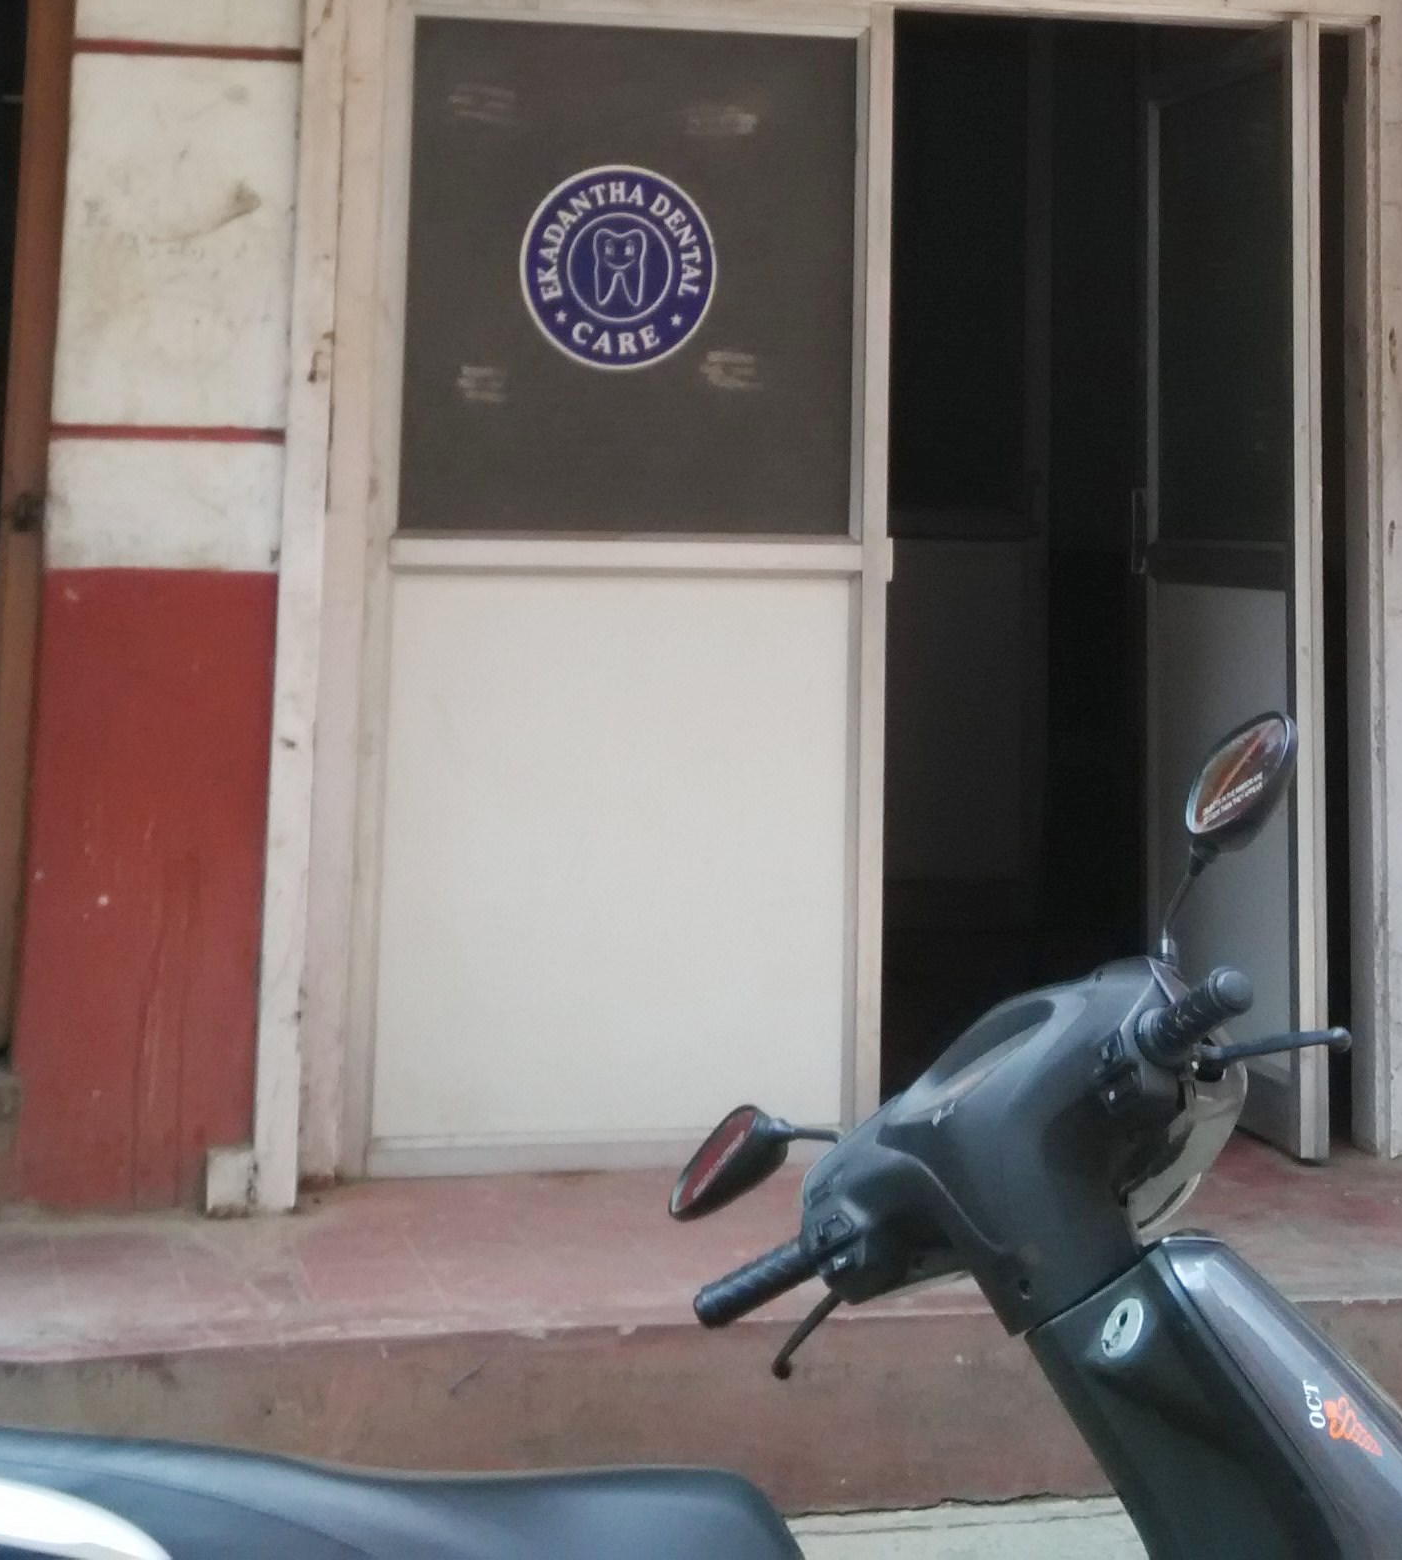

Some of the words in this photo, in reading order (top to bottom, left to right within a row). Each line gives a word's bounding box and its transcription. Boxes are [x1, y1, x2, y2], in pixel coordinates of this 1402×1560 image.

[537, 181, 645, 302] EKADANTHA
[649, 193, 702, 297] DENTAL
[571, 321, 660, 355] CARE
[1303, 1380, 1326, 1429] OCT
